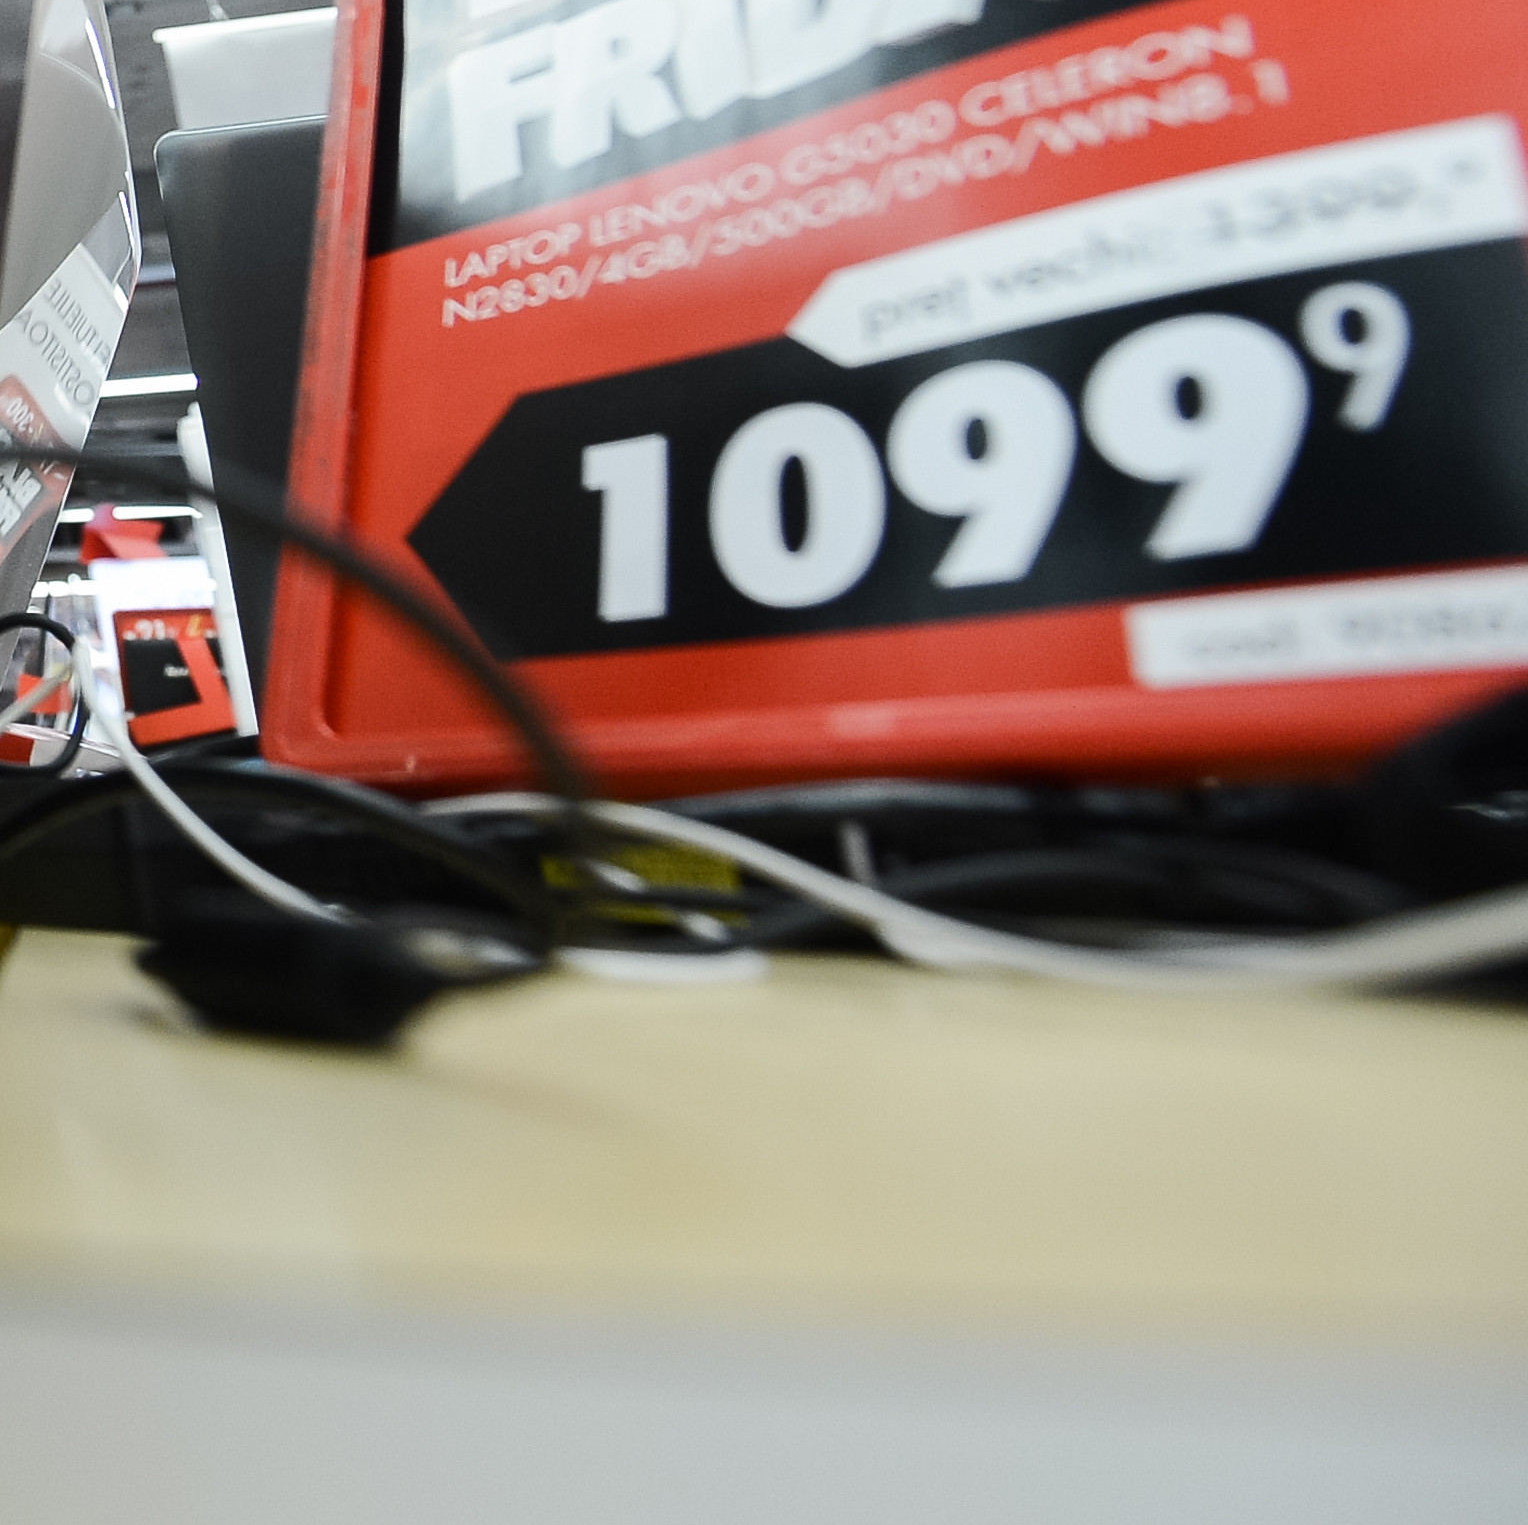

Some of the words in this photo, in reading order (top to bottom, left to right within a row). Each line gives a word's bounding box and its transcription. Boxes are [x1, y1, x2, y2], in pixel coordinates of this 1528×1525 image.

[444, 220, 581, 289] LAPTOP
[589, 160, 776, 247] LENOVO
[959, 13, 1256, 129] CELERON
